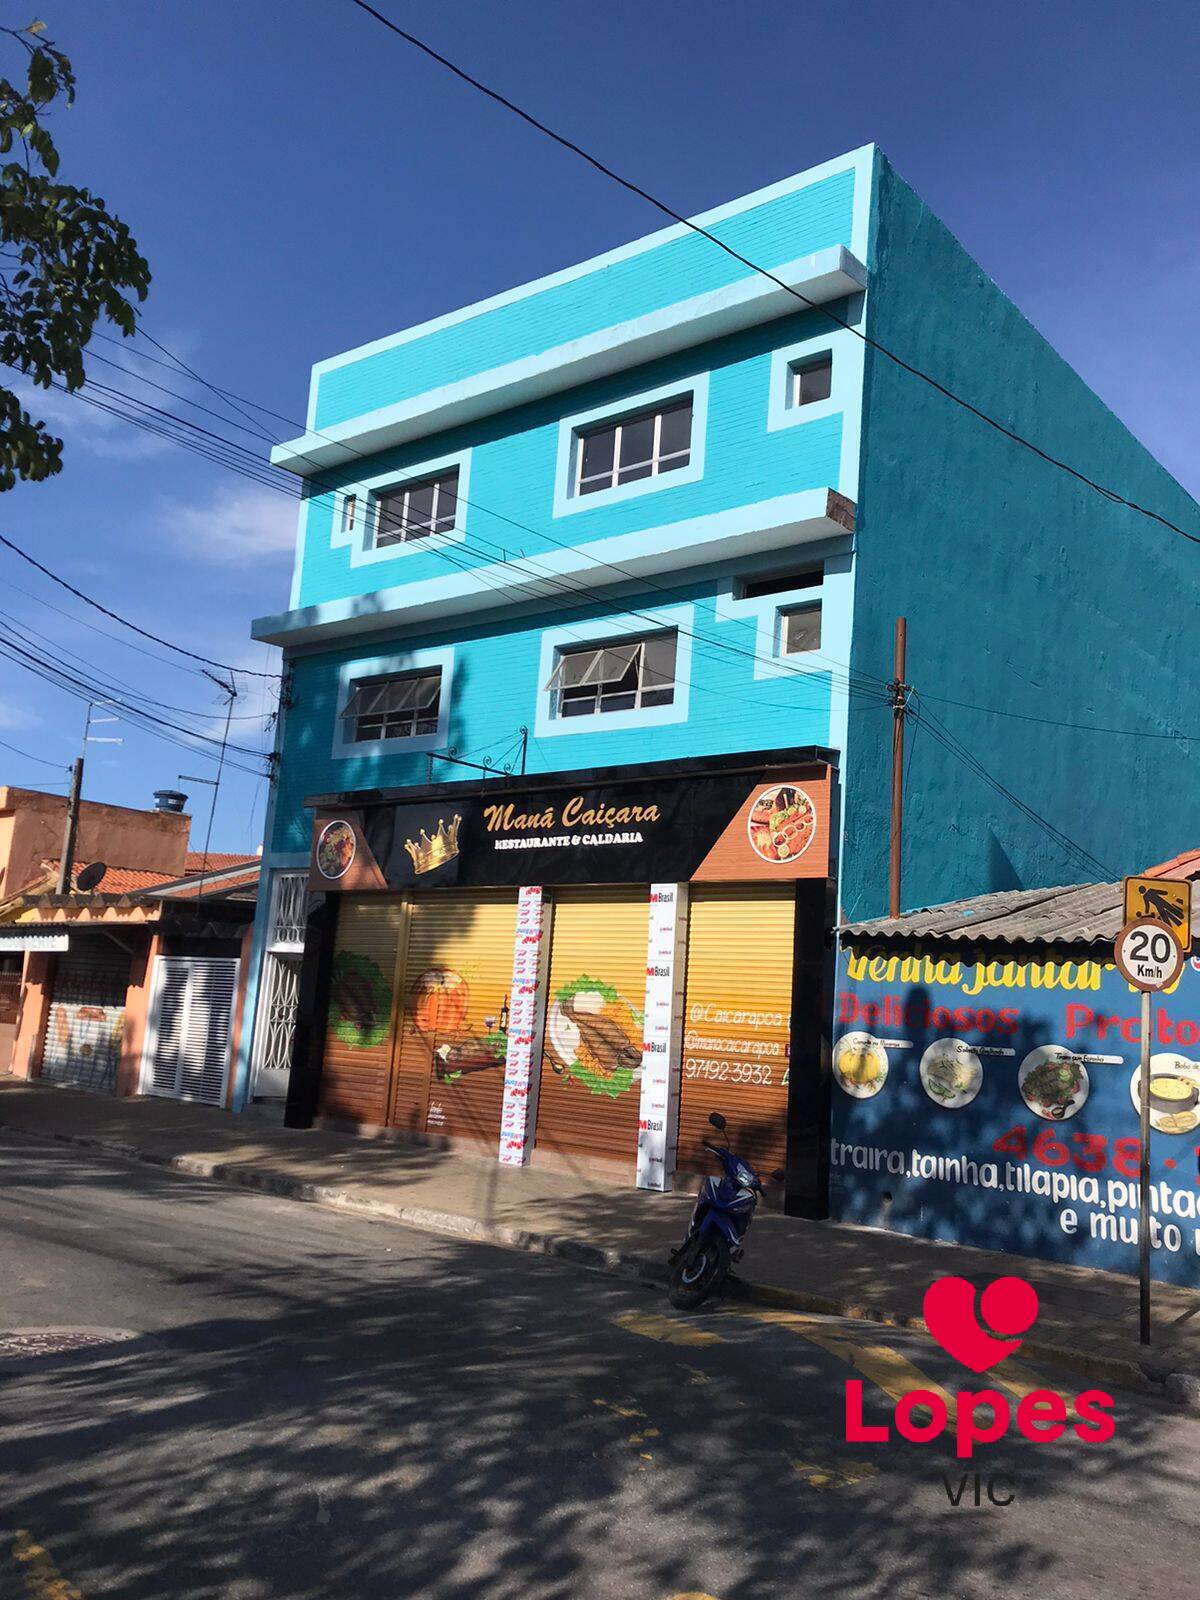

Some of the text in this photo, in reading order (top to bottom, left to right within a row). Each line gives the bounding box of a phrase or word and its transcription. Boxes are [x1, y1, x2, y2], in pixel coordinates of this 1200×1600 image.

[561, 796, 661, 828] Caiçara
[494, 836, 570, 850] RESTAURANTE
[582, 832, 643, 847] CALDARIA
[1129, 931, 1171, 964] 20
[1137, 964, 1163, 978] Km/h
[1060, 1208, 1078, 1234] e
[1090, 1211, 1181, 1252] muto
